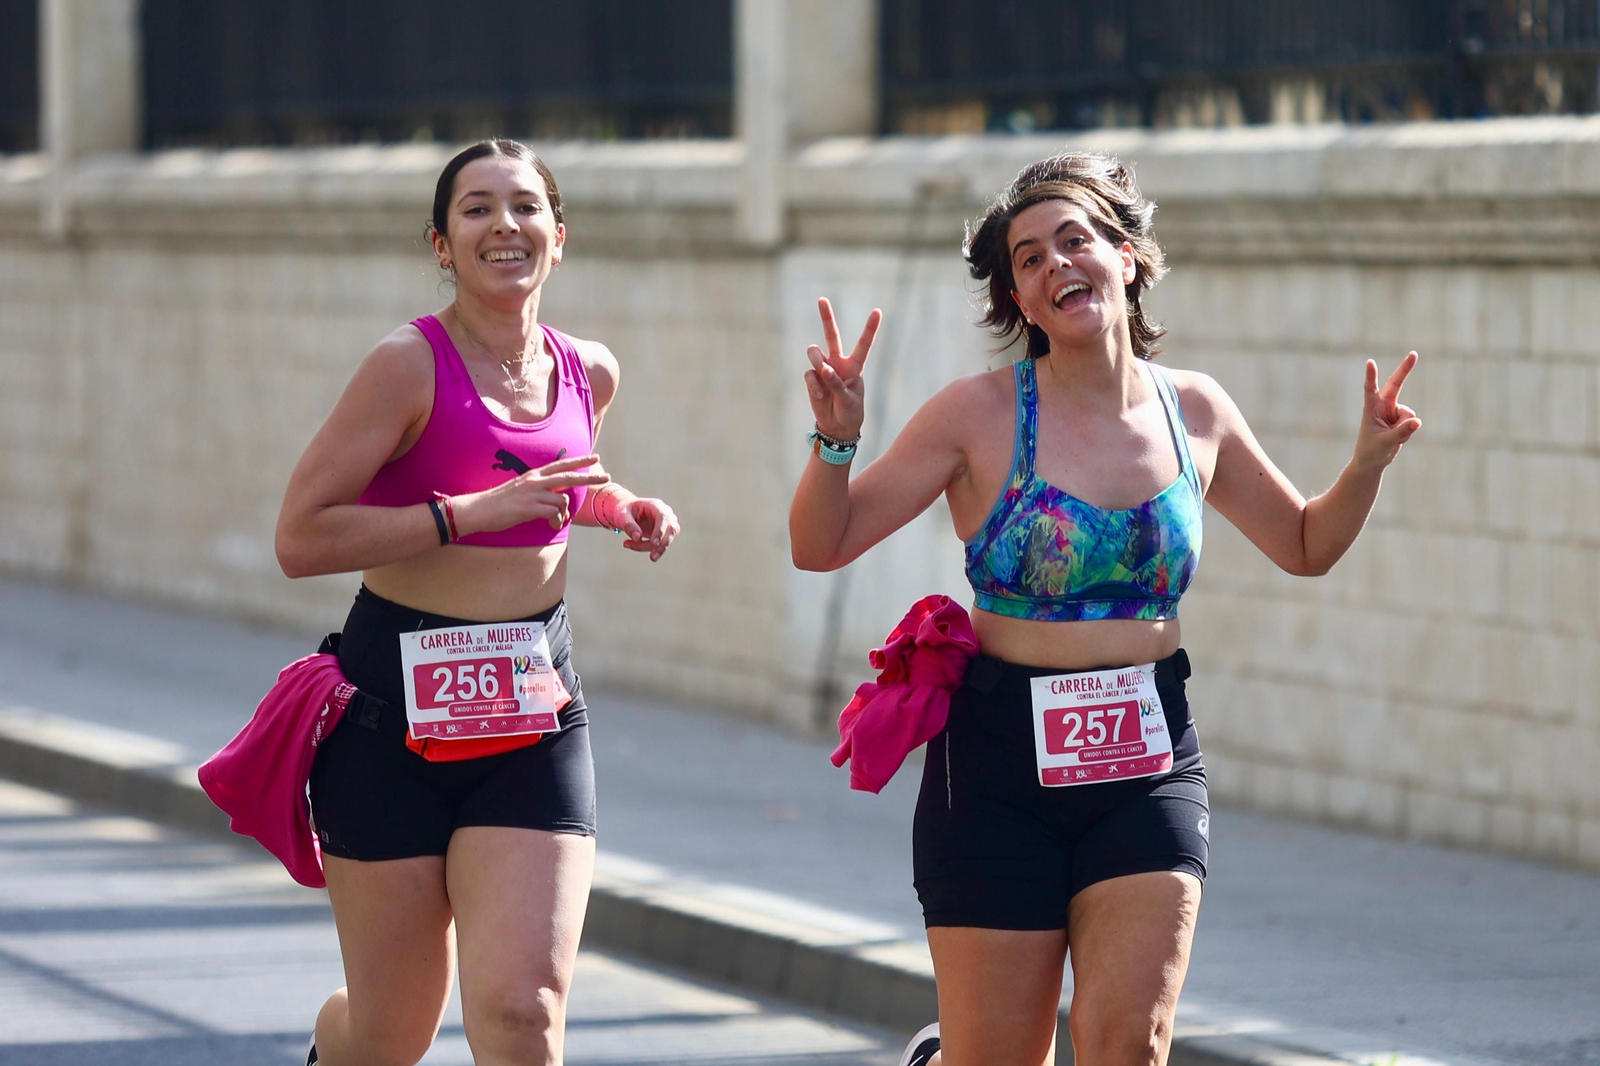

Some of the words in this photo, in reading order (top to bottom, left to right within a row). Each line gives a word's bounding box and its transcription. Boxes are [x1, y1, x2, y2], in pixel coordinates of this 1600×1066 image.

[420, 631, 473, 650] CARRERA
[487, 627, 532, 644] MUJERES
[473, 645, 490, 653] CÁNCER
[495, 643, 513, 651] MÁLAGA
[432, 663, 500, 702] 256
[1051, 676, 1103, 695] CARRERA
[1106, 682, 1114, 690] DE
[1117, 670, 1145, 688] MUJERS
[1076, 692, 1095, 701] CONTRA
[1095, 691, 1102, 699] EL
[1102, 689, 1120, 698] CÁNCER
[1124, 687, 1139, 696] MÁLAGA
[473, 704, 491, 712] CONTRA
[492, 703, 498, 711] EL
[498, 702, 516, 711] CÁNCER
[1062, 707, 1127, 747] 257
[1102, 748, 1121, 757] CONTRA
[1121, 747, 1127, 755] EL
[1127, 745, 1143, 754] CÁNCER
